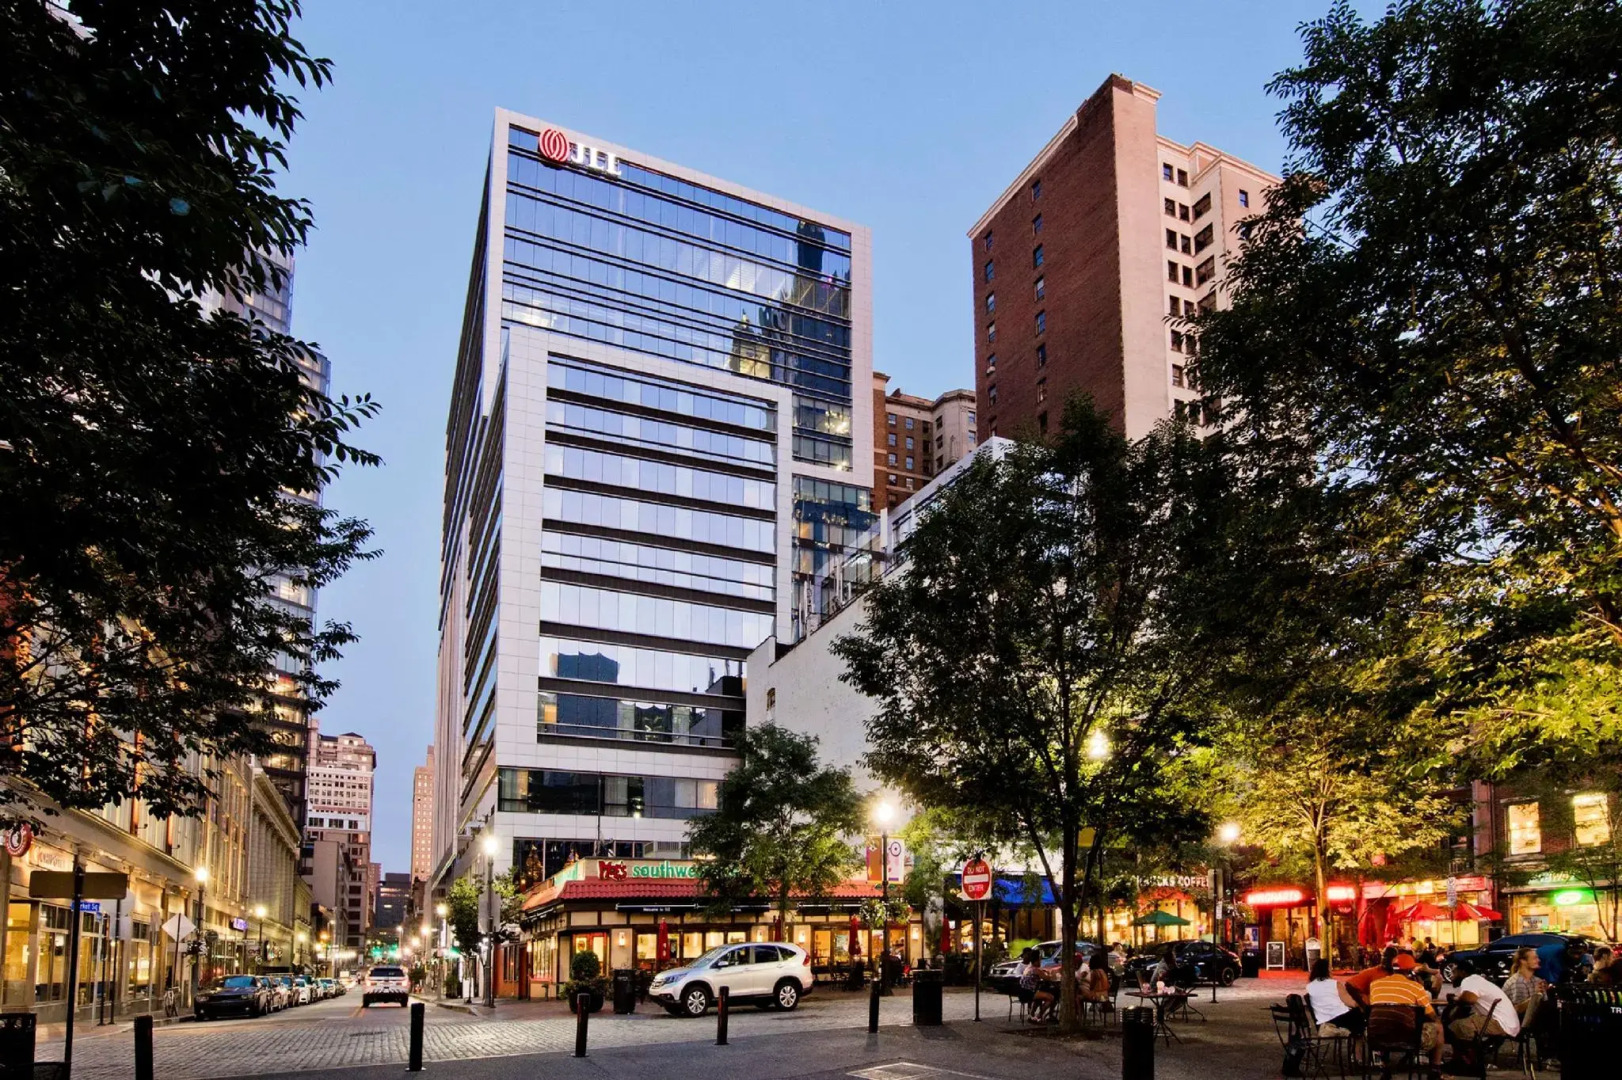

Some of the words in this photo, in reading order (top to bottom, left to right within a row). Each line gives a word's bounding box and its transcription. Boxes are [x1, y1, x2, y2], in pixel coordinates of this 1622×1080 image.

[570, 141, 622, 176] JLL
[967, 866, 975, 874] DO
[975, 865, 985, 873] NOT
[968, 883, 984, 892] ENTER
